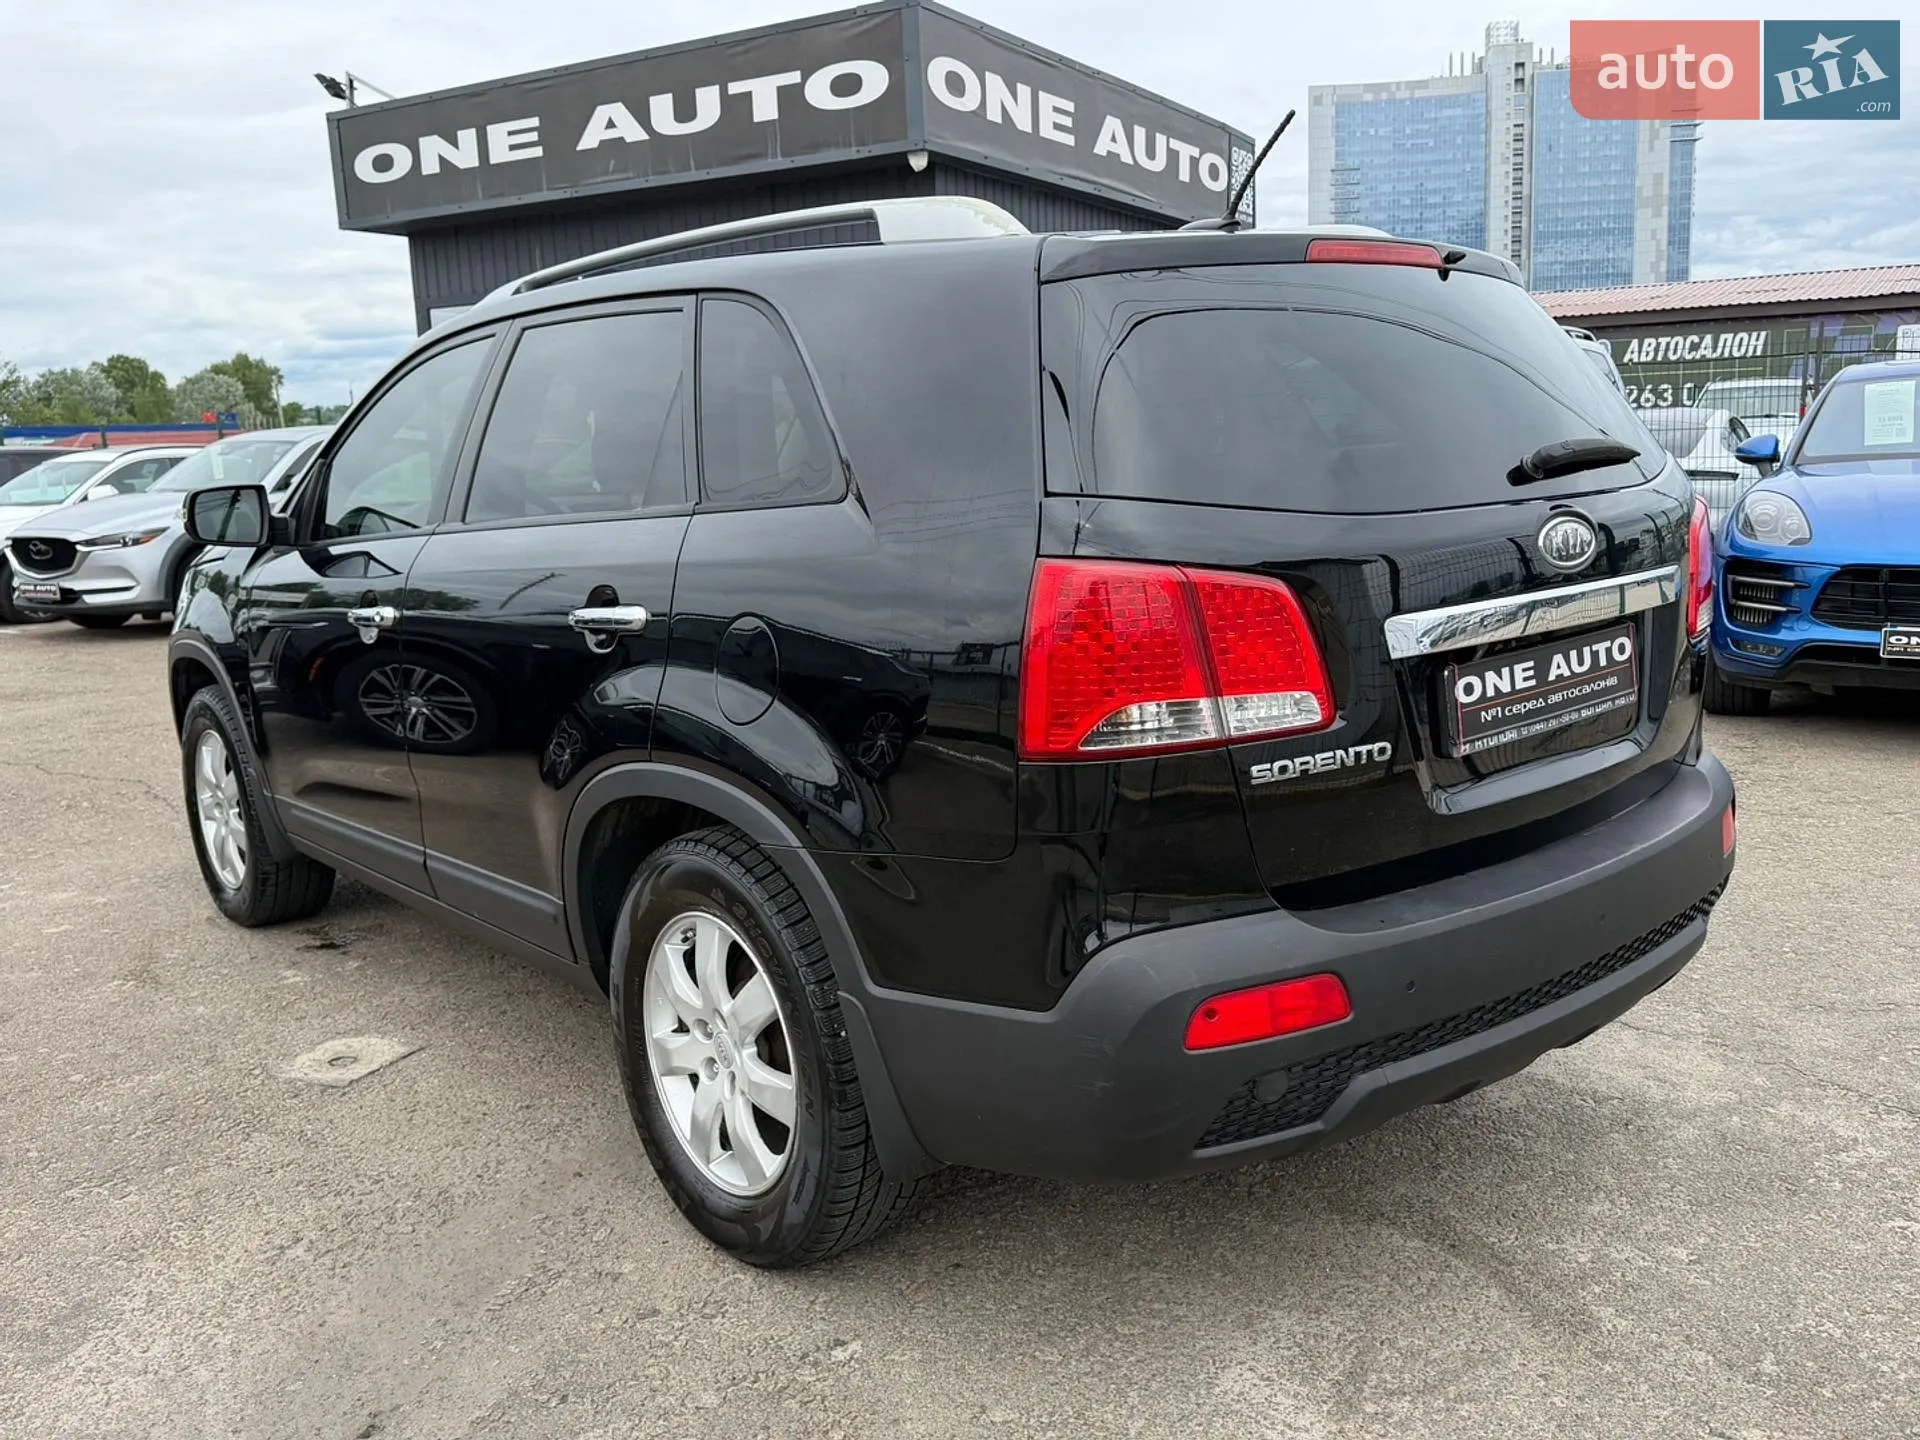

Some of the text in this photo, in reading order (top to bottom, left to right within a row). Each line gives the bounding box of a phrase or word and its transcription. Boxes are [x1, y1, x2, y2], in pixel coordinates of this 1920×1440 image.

[354, 60, 890, 184] ONE AUTO
[927, 56, 1228, 192] ONE AUTO
[1623, 330, 1768, 363] АВТОСАЛОН
[1454, 636, 1631, 703] ONE AUTO
[1505, 698, 1546, 716] серед
[1547, 675, 1619, 704] автосалонів
[1250, 741, 1392, 785] SORENTO
